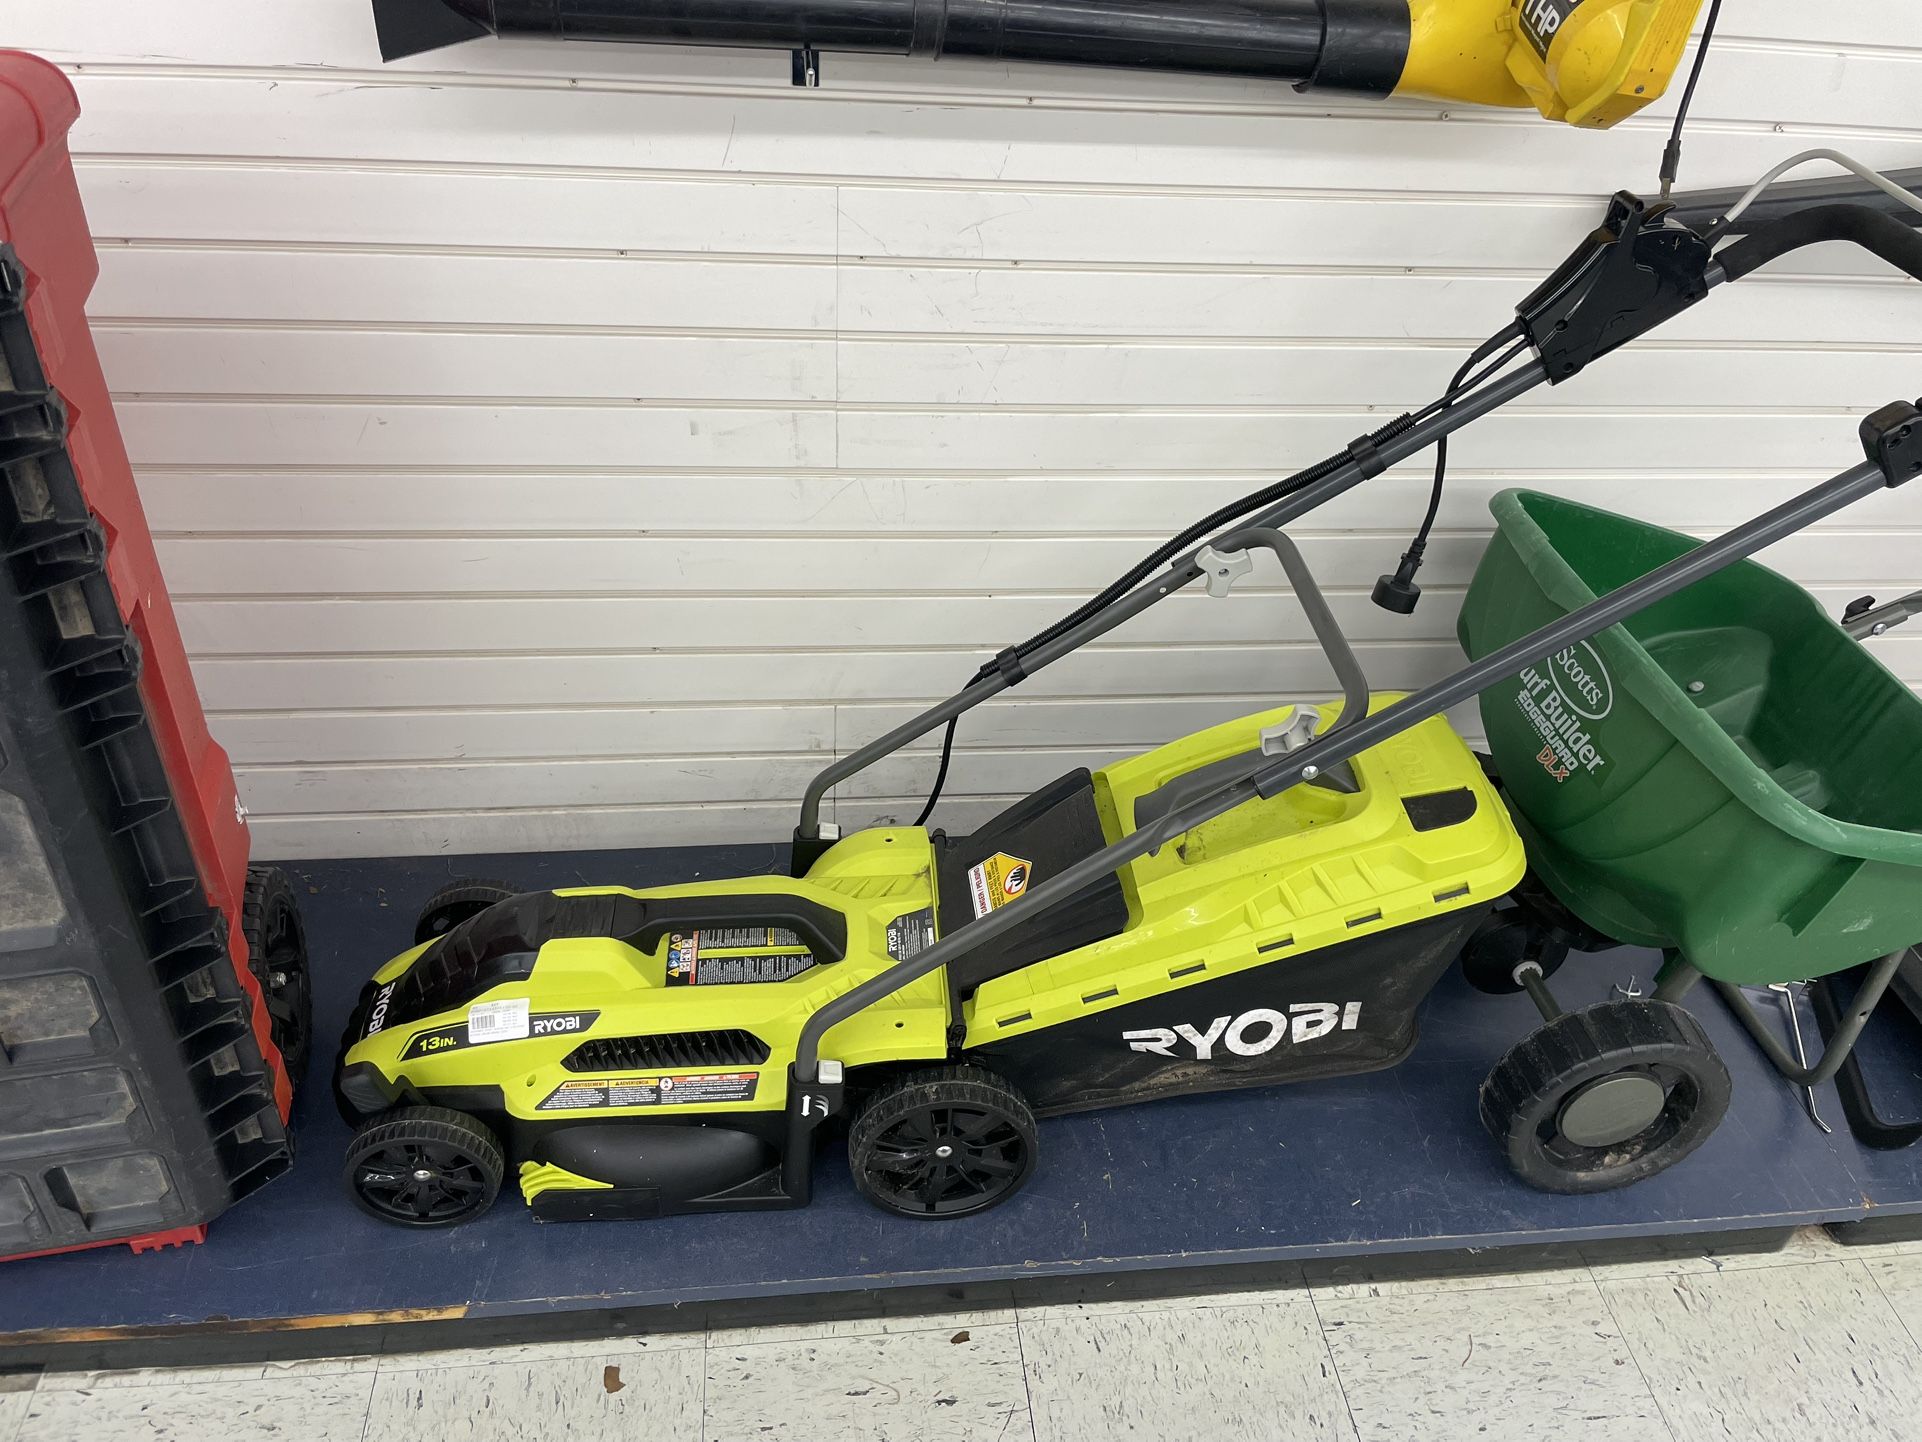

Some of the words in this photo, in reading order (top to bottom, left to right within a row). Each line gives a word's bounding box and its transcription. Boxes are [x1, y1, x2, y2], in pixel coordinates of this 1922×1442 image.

[1519, 667, 1551, 697] urf
[1536, 744, 1570, 782] DLX
[888, 928, 897, 952] RYOBI
[533, 1015, 581, 1034] RYOBI
[1122, 1001, 1363, 1060] RYOBI
